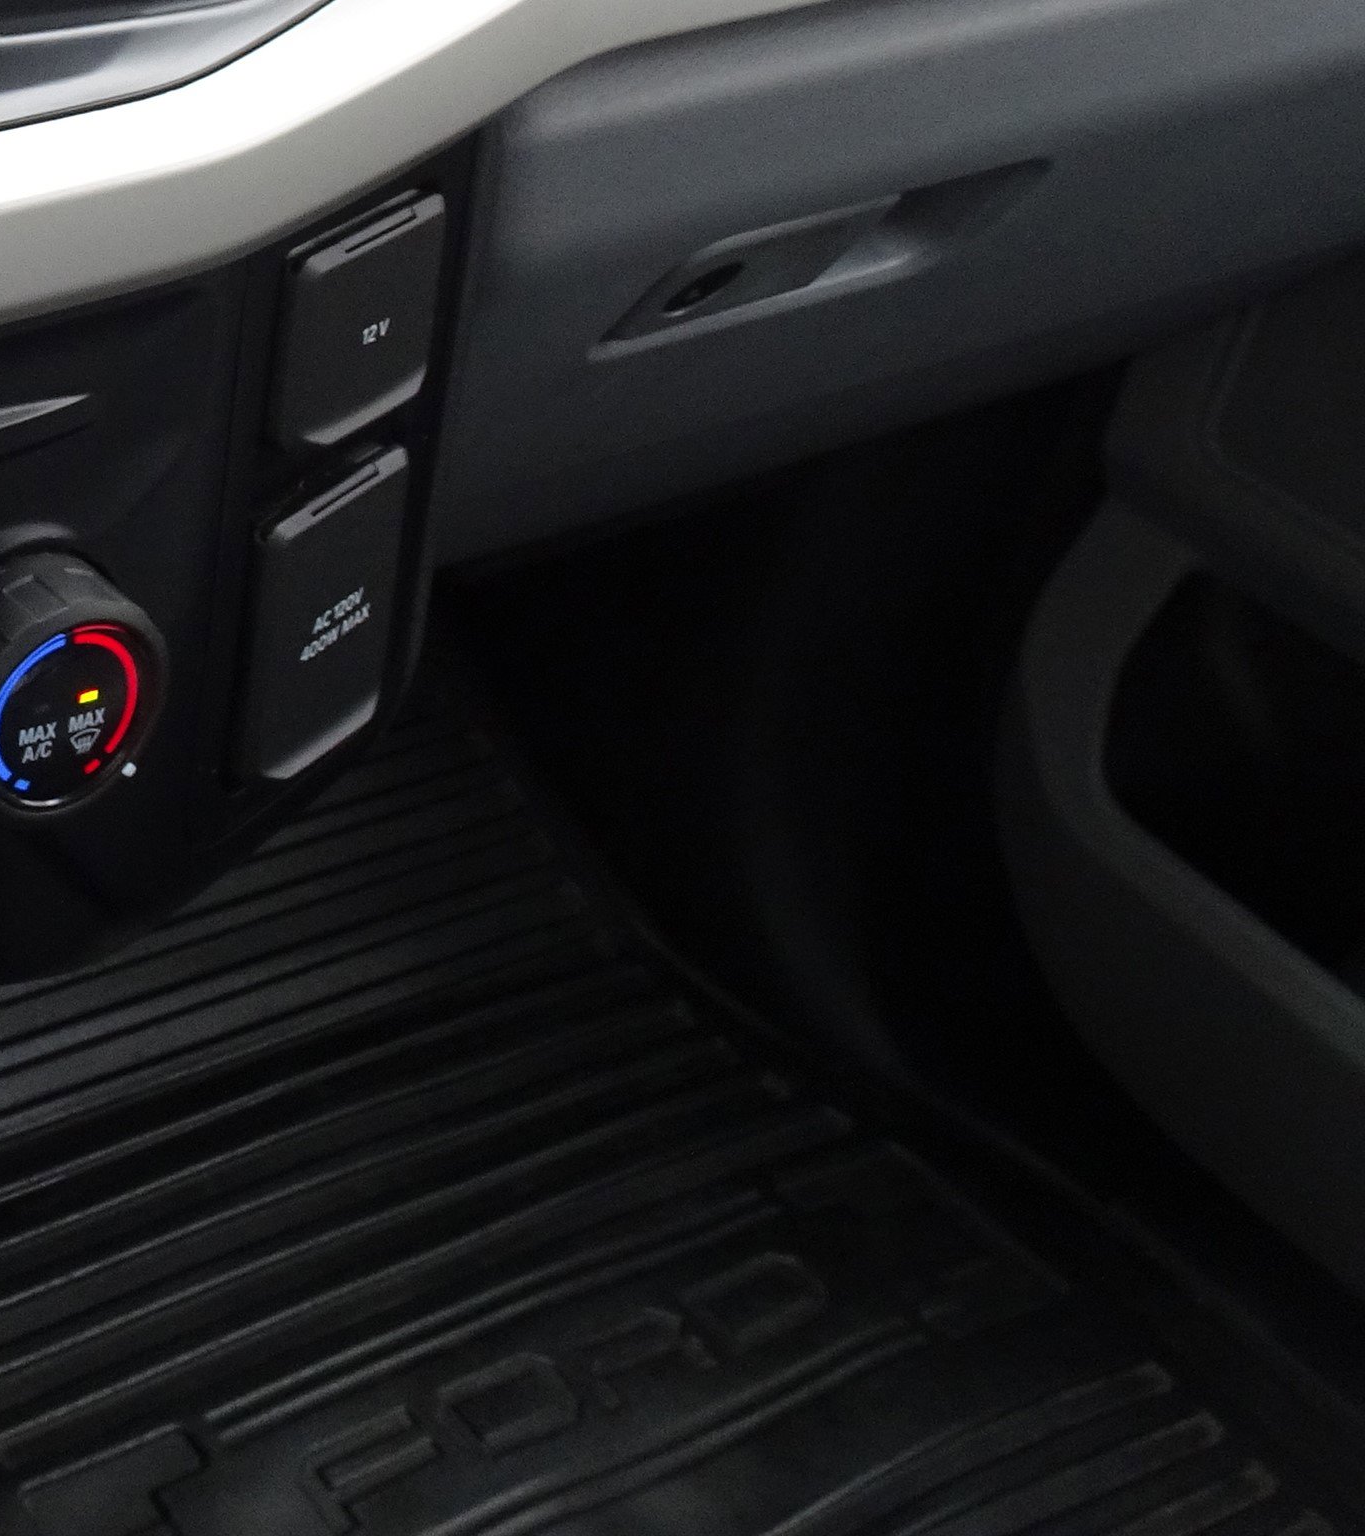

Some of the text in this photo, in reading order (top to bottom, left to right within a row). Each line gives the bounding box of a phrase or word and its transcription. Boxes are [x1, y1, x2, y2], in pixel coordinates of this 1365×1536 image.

[339, 602, 371, 636] MAX
[68, 707, 106, 734] MAX
[18, 721, 57, 747] MAX
[21, 740, 53, 764] A/C
